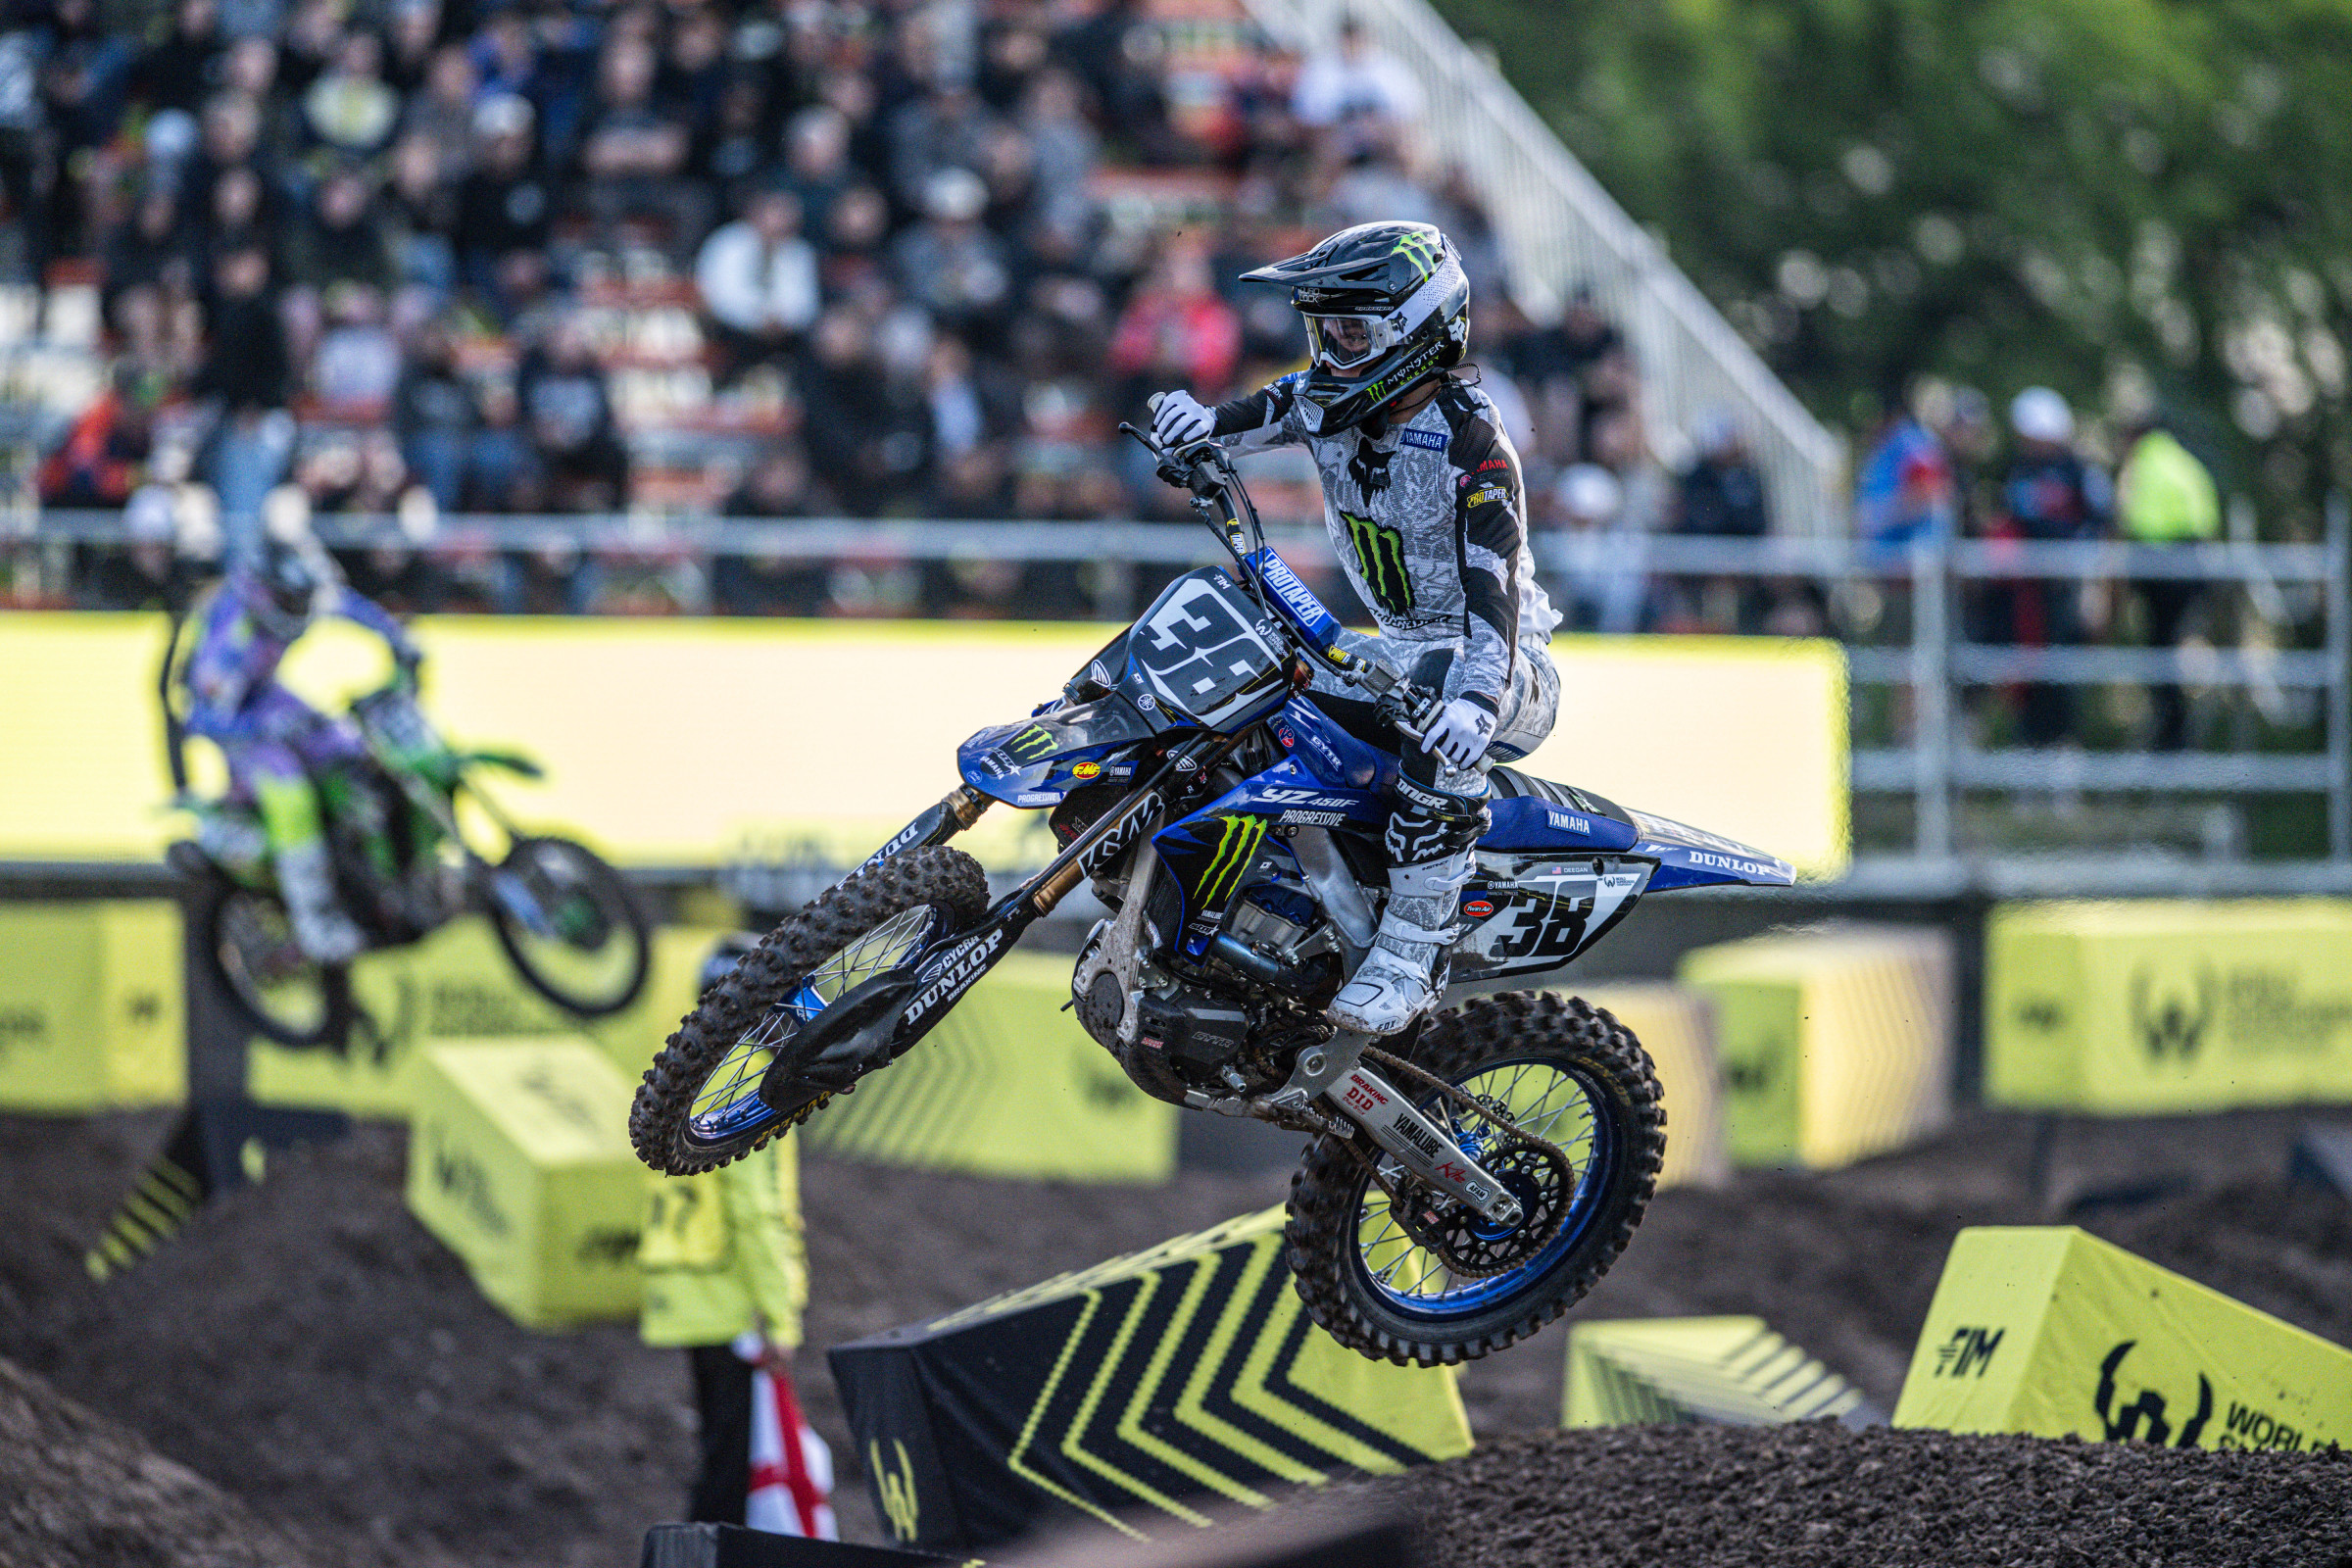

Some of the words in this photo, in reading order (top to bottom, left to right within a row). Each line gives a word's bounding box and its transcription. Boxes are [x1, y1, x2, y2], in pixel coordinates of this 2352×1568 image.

[1299, 294, 1318, 303] LOCK
[1387, 341, 1445, 385] MONSTER
[1399, 355, 1440, 385] ENERGY
[1405, 431, 1442, 449] YAMAHA
[1471, 459, 1508, 474] MAHA
[1468, 488, 1507, 506] PROTAPER
[1214, 573, 1231, 590] FIM
[1265, 557, 1323, 623] PROTAPER
[1130, 593, 1282, 716] 38
[1311, 735, 1343, 767] GYTR
[980, 756, 1005, 780] YAMAHA
[1072, 762, 1102, 776] FMF
[1018, 793, 1056, 804] PROGRESSIVE
[1251, 788, 1319, 805] YZ
[1307, 798, 1360, 808] 450F
[1278, 809, 1347, 827] PROGRESSIVE
[1548, 810, 1591, 834] YAMAHA
[1422, 859, 1449, 871] INSTINCT
[1689, 851, 1771, 876] DUNLOP
[1488, 880, 1596, 957] 38
[942, 935, 981, 968] CYCRA
[905, 928, 1003, 1026] DUNLOP
[947, 963, 987, 1003] BRAKING
[1378, 1019, 1396, 1031] FOX
[1192, 1031, 1235, 1048] GYTR
[1350, 1074, 1389, 1105] BRAKING
[1393, 1113, 1443, 1158] YAMALUBE
[1469, 1185, 1486, 1199] AFAM
[1935, 1327, 2006, 1378] FIM
